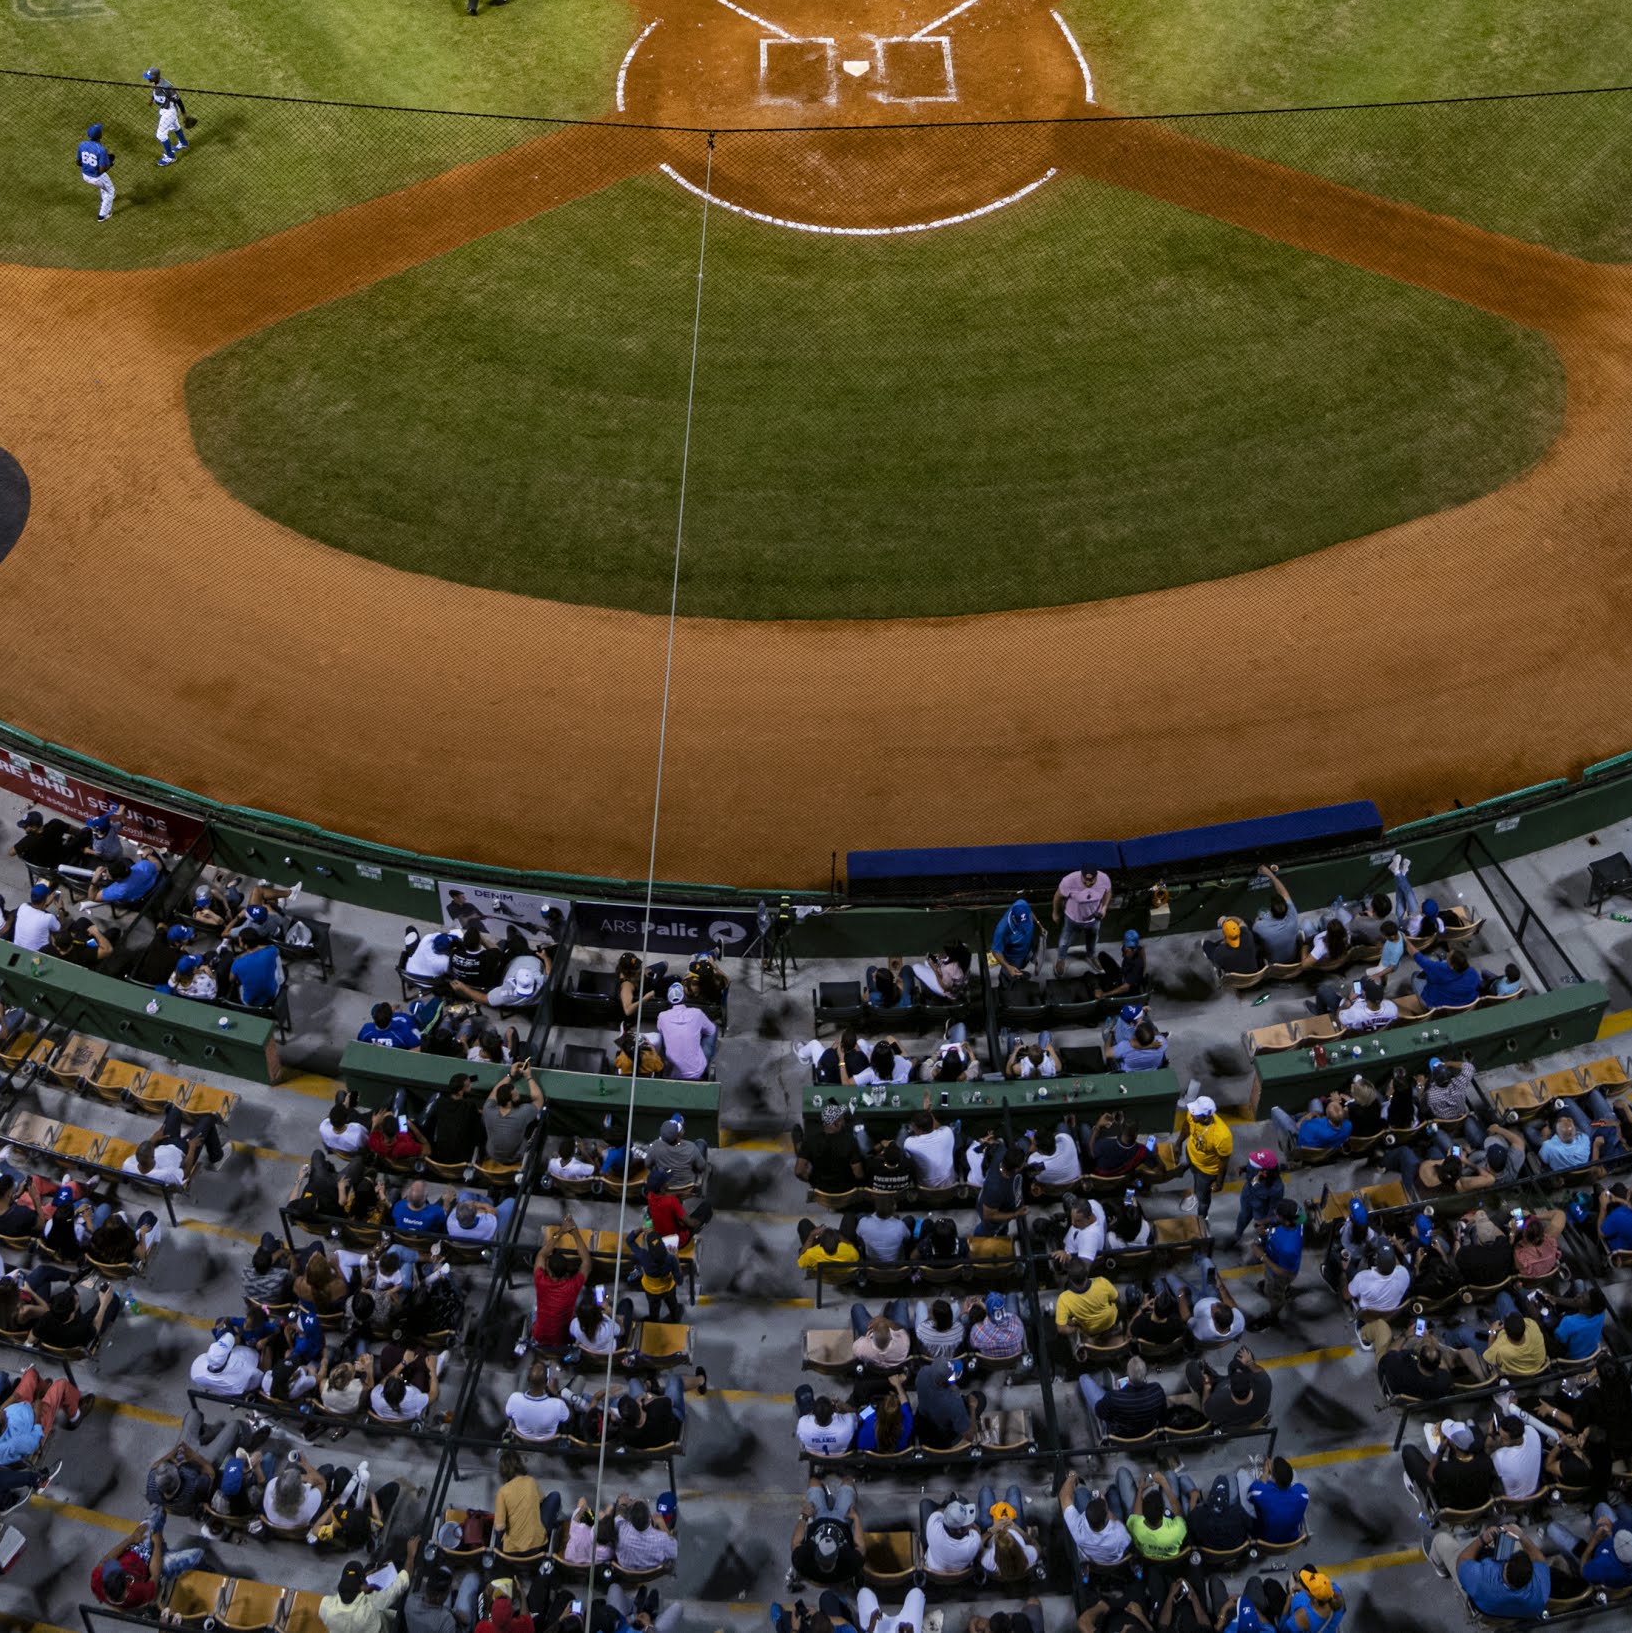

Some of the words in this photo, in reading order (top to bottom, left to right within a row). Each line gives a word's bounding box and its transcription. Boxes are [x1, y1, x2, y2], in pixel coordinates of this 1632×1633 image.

[28, 770, 75, 800] BHD
[121, 825, 172, 846] confianza
[473, 889, 514, 903] DENIM
[599, 918, 636, 934] ARS
[639, 921, 699, 938] Palic
